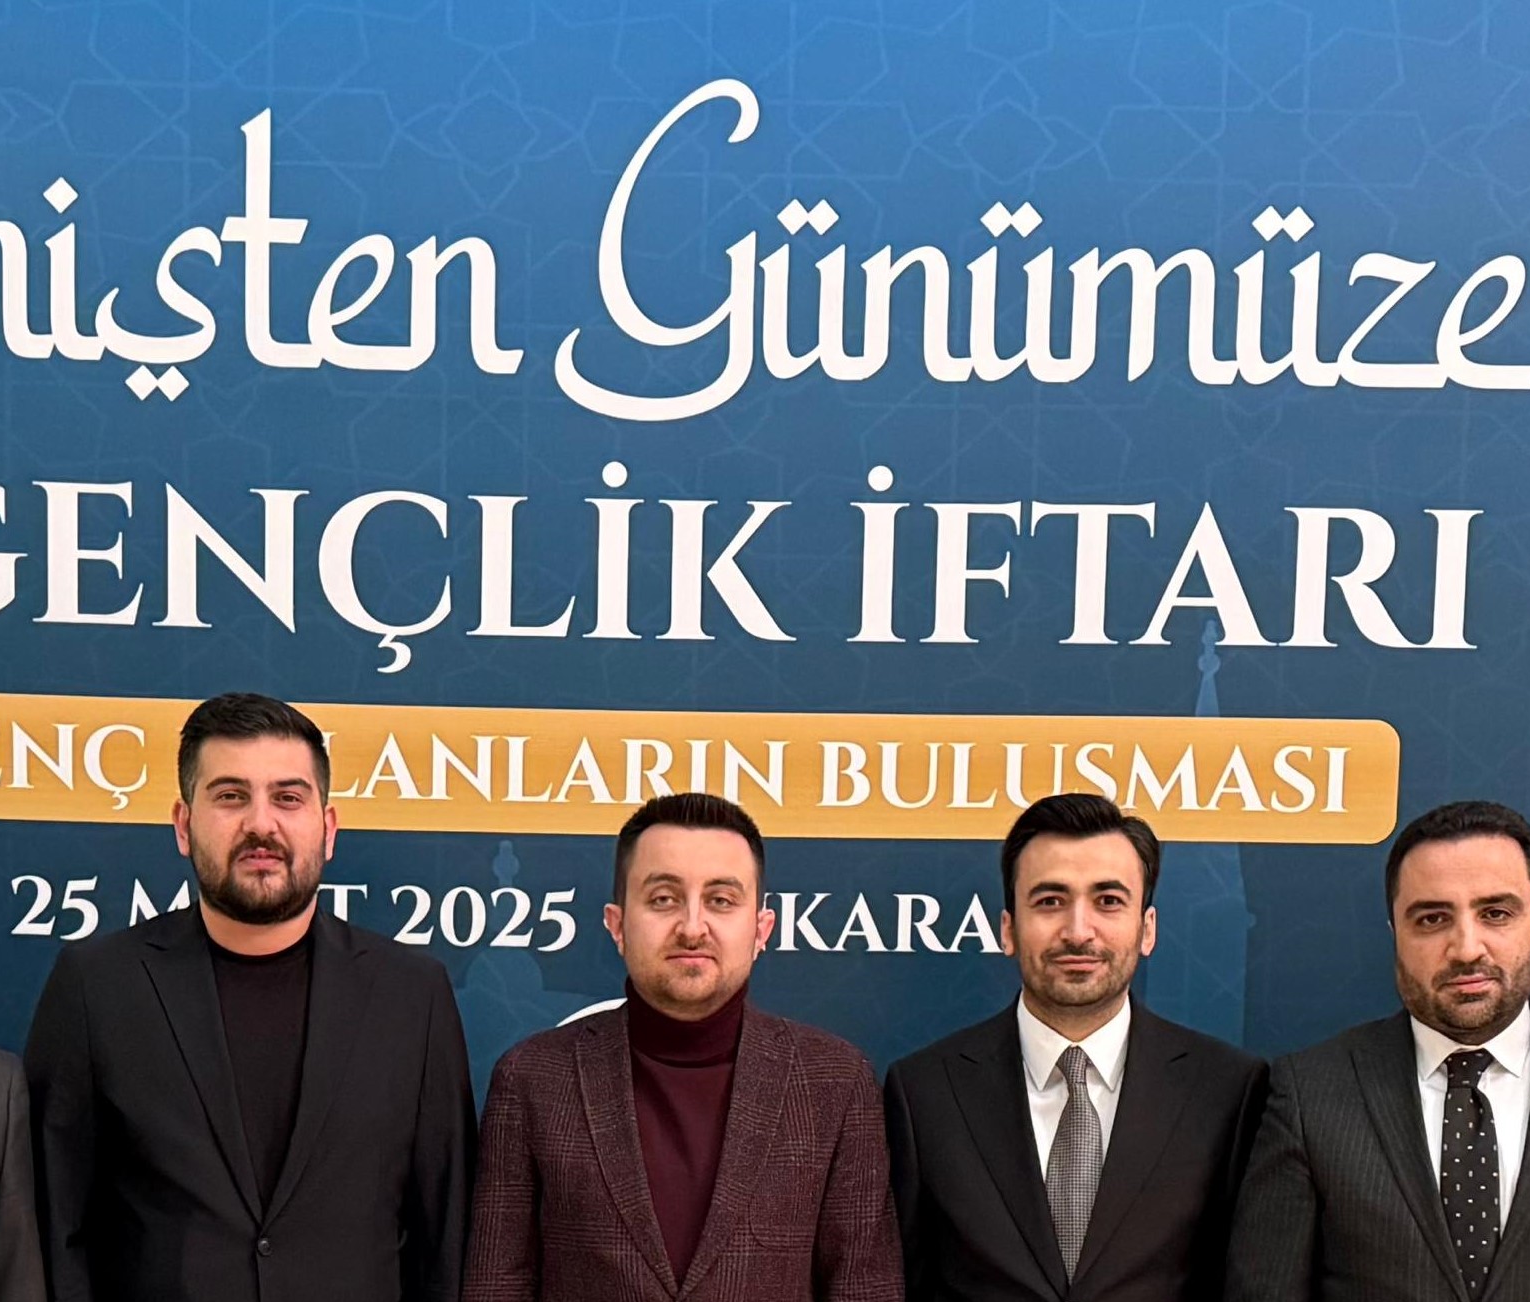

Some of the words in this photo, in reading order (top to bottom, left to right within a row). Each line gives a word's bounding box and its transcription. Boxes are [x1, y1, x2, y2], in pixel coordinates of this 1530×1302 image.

[846, 465, 1485, 649] İFTARI
[322, 730, 786, 806] LANLARIN
[10, 875, 100, 941] 25
[390, 884, 576, 953] 2025
[755, 892, 1004, 953] KARA
